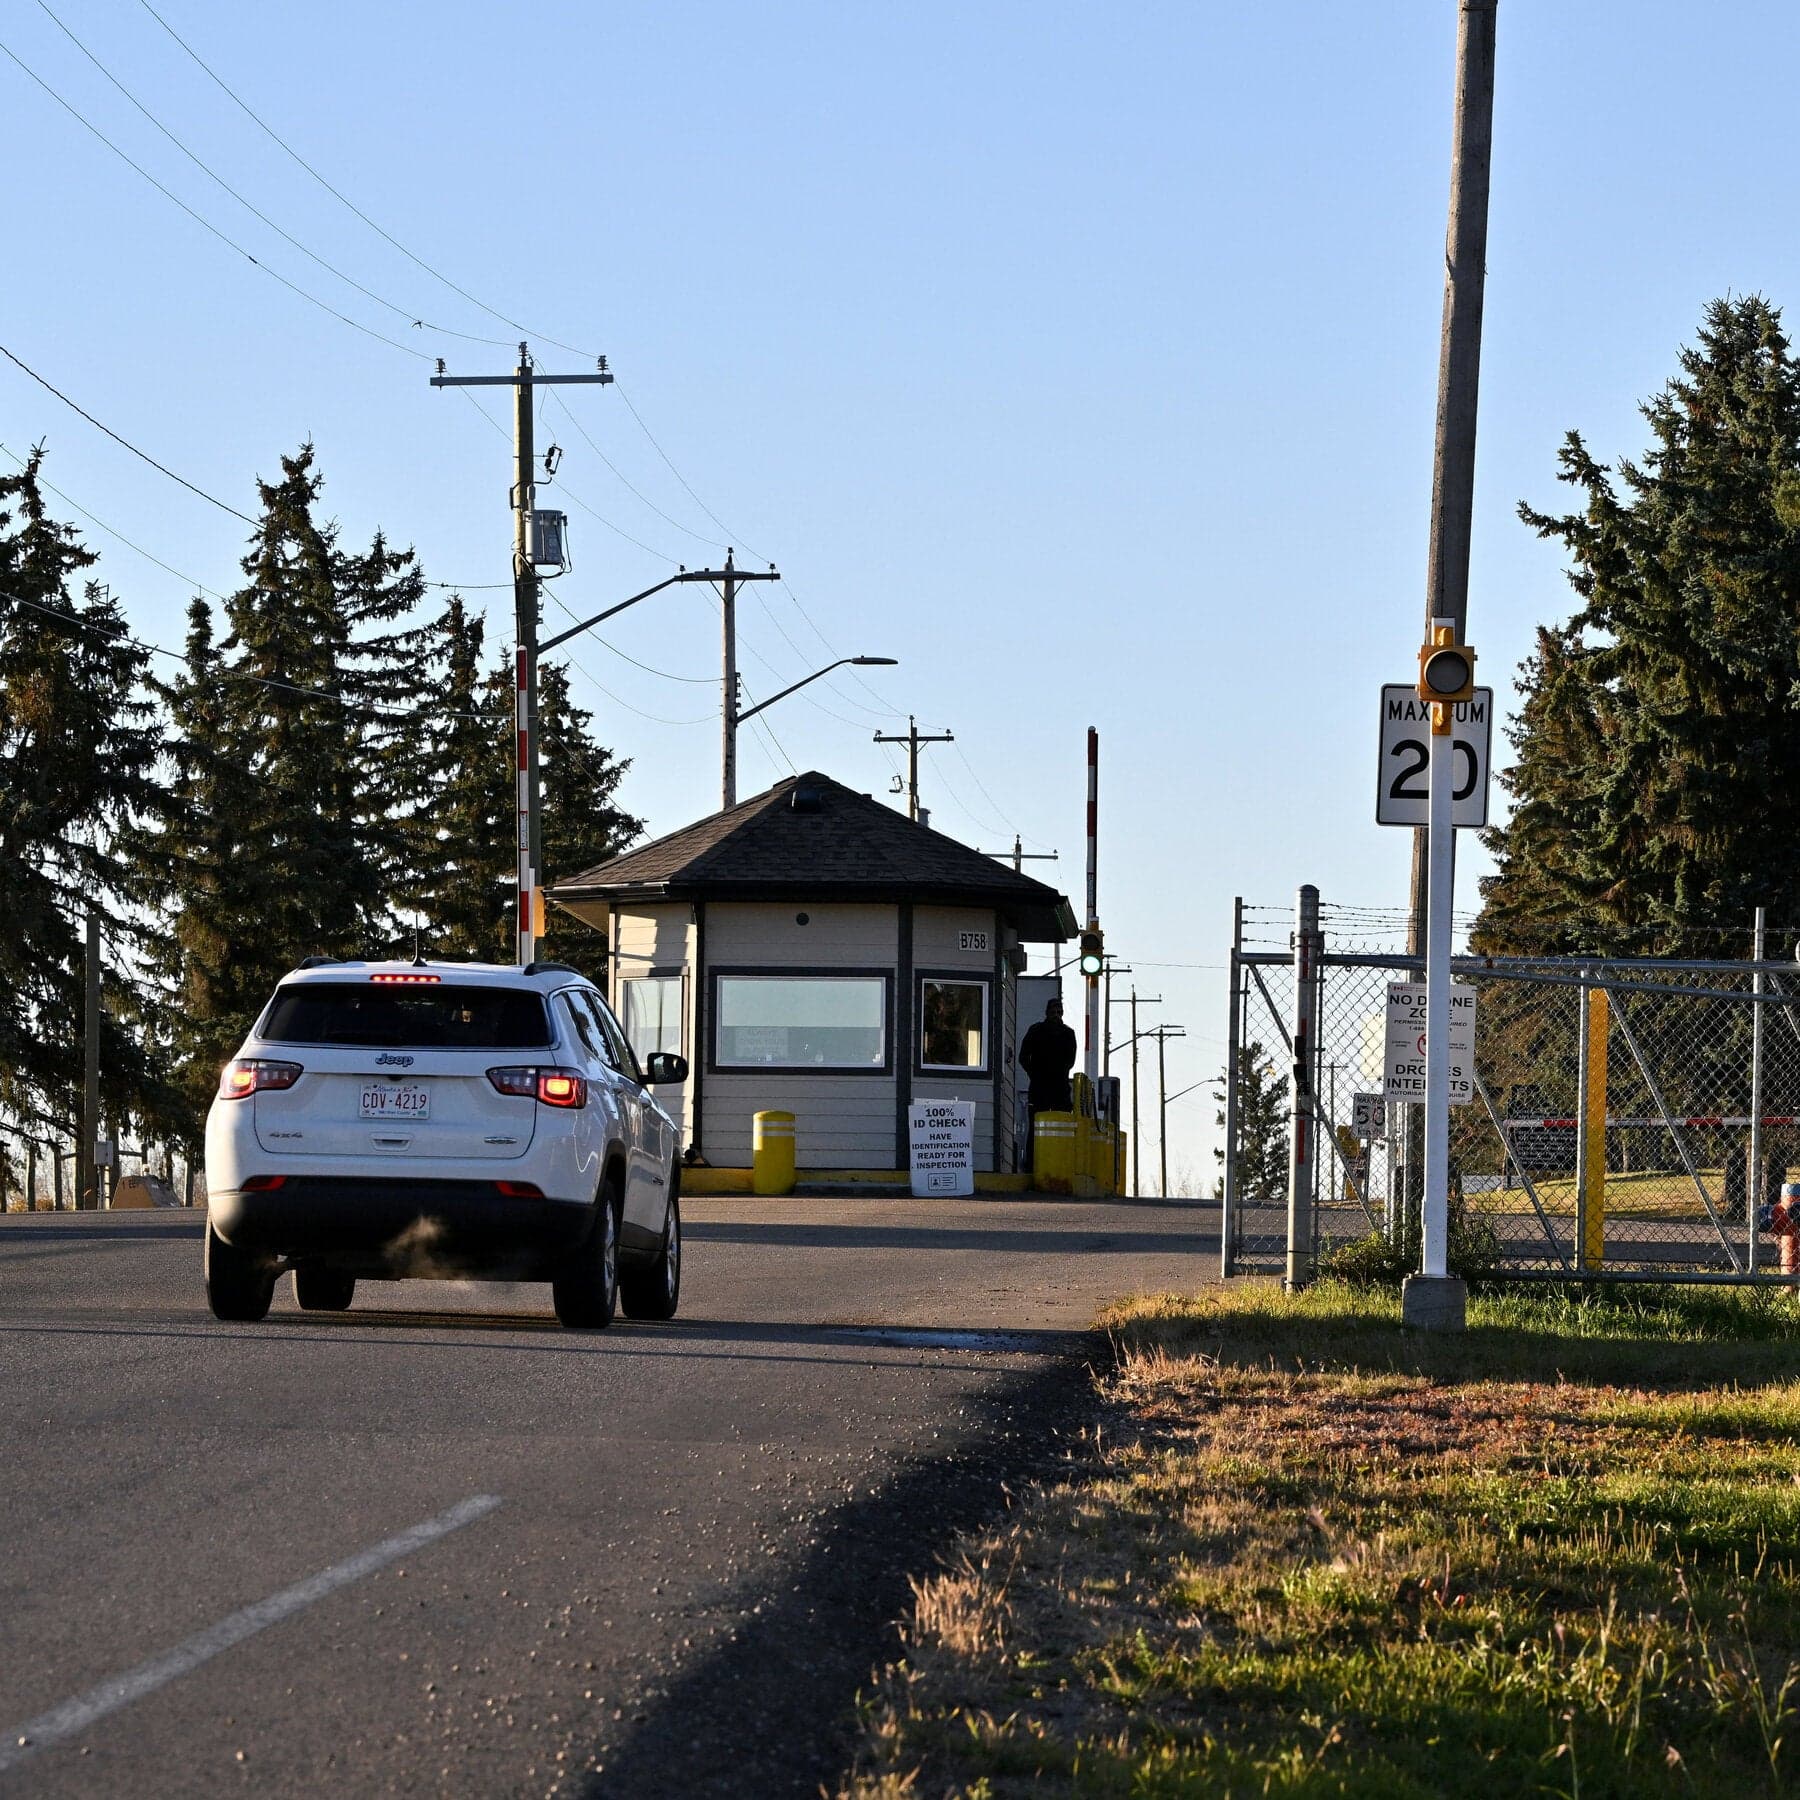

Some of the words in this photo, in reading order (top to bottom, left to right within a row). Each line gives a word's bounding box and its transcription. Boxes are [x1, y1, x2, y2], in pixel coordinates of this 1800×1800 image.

[1388, 700, 1484, 723] MAXUM
[1389, 739, 1478, 801] 20
[961, 933, 986, 949] B758
[1389, 994, 1412, 1005] NO
[1418, 995, 1473, 1008] DNE
[375, 1053, 414, 1067] Jeep
[1386, 1078, 1469, 1091] INTETS
[362, 1093, 427, 1110] CDV-4219
[925, 1108, 955, 1117] 100%
[914, 1119, 925, 1128] ID
[928, 1119, 966, 1128] CHECK
[929, 1133, 952, 1141] HAVE
[912, 1142, 970, 1150] IDENTIFICATION
[918, 1152, 945, 1160] READY
[916, 1161, 967, 1169] INSPECTION
